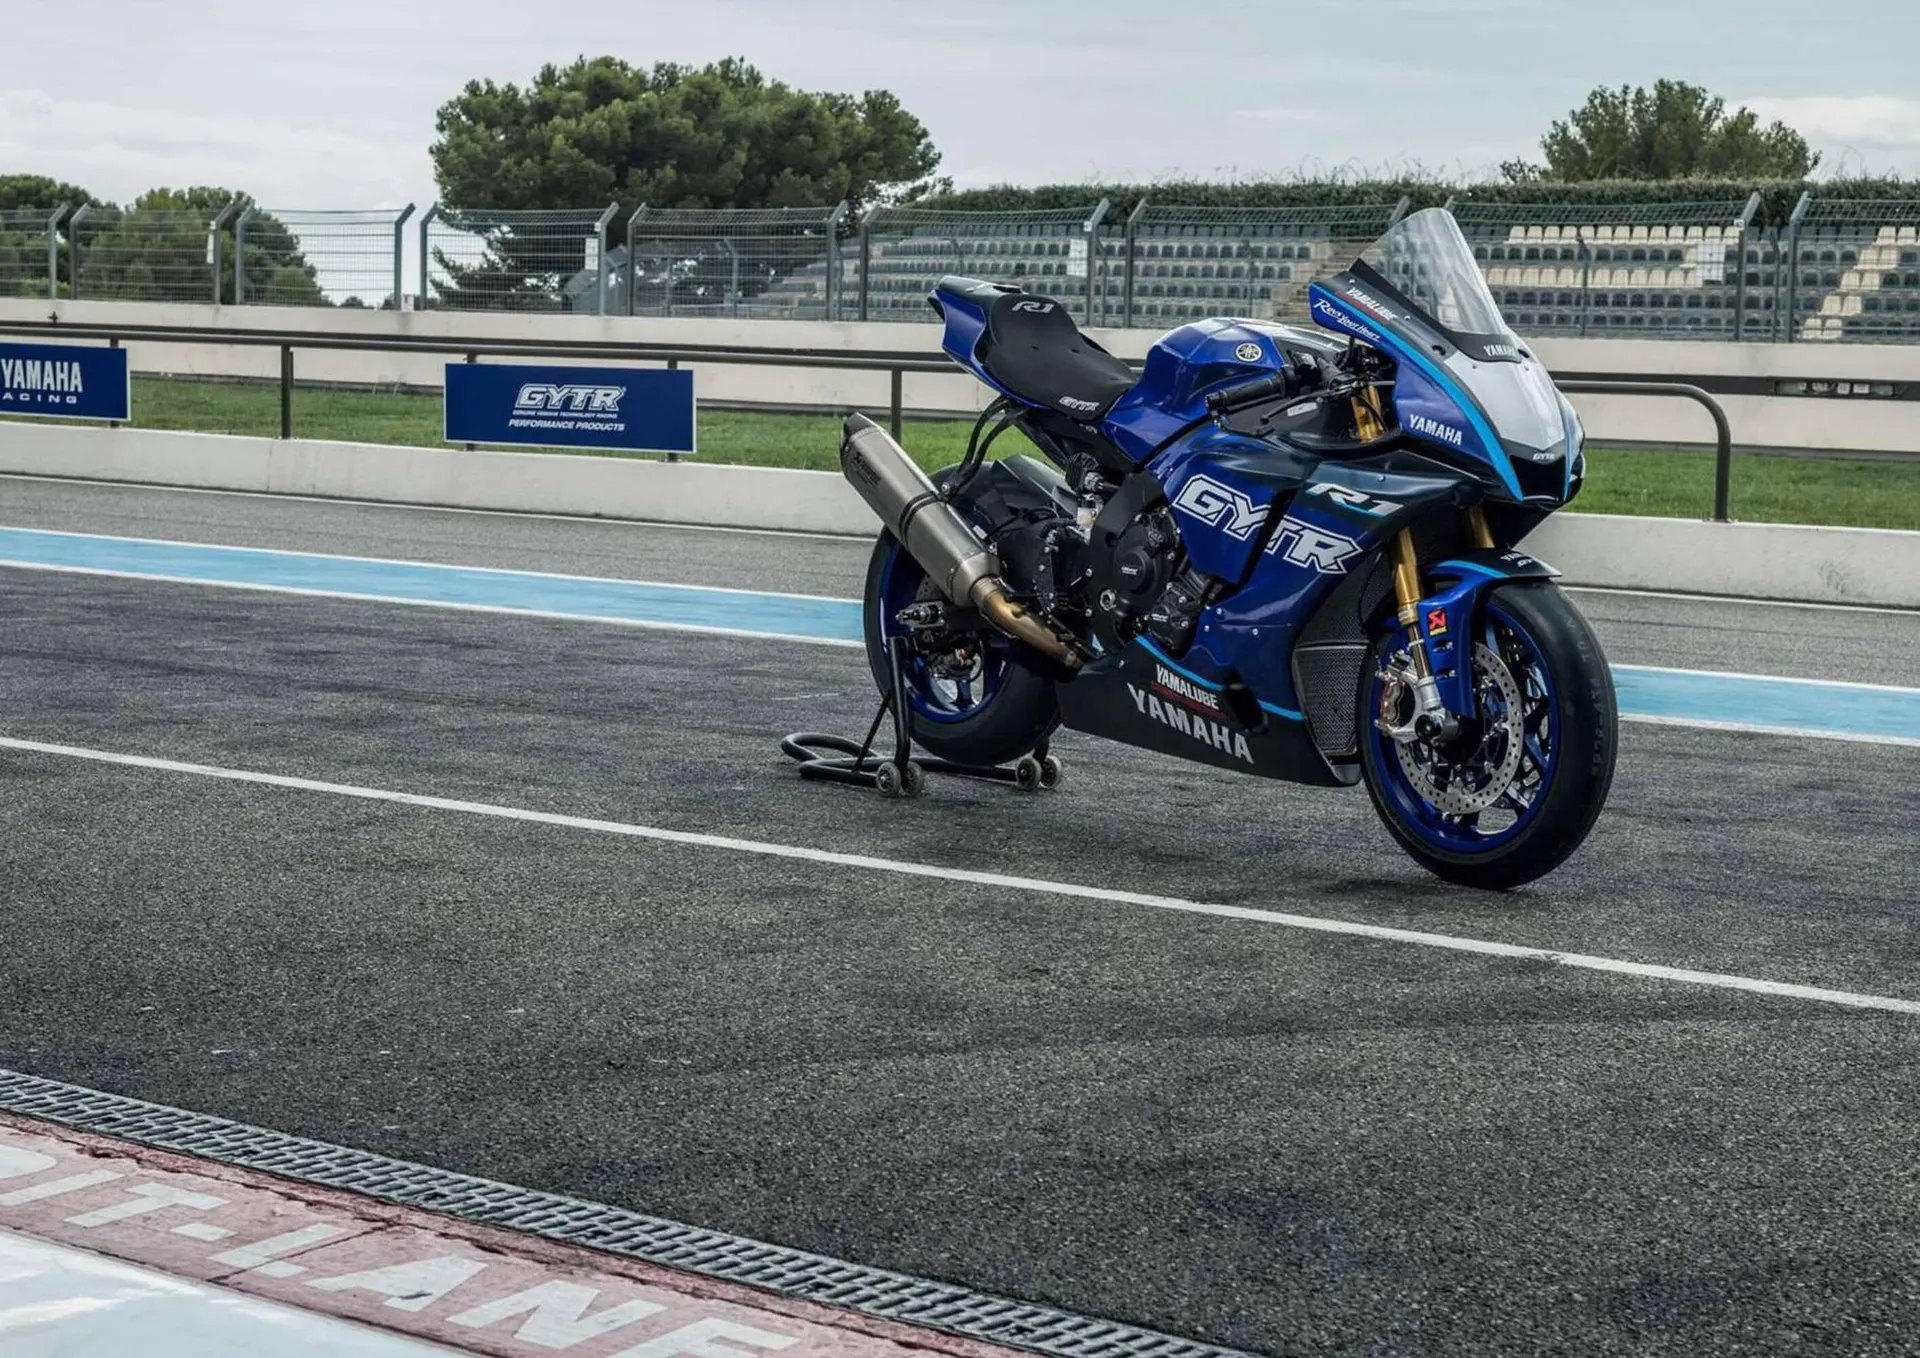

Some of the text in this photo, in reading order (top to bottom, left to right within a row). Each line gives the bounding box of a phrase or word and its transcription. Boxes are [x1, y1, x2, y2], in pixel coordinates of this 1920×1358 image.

[1011, 300, 1055, 314] R1
[1, 358, 84, 393] YAMAHA
[1, 391, 79, 404] ACING
[508, 418, 625, 432] PERFORMANCE PRODUCTS
[1409, 414, 1463, 446] YAMAHA
[1304, 482, 1404, 518] R1
[1172, 473, 1363, 575] GYTR
[1156, 663, 1220, 710] YAMALUBE
[1126, 682, 1255, 765] YAMAHA
